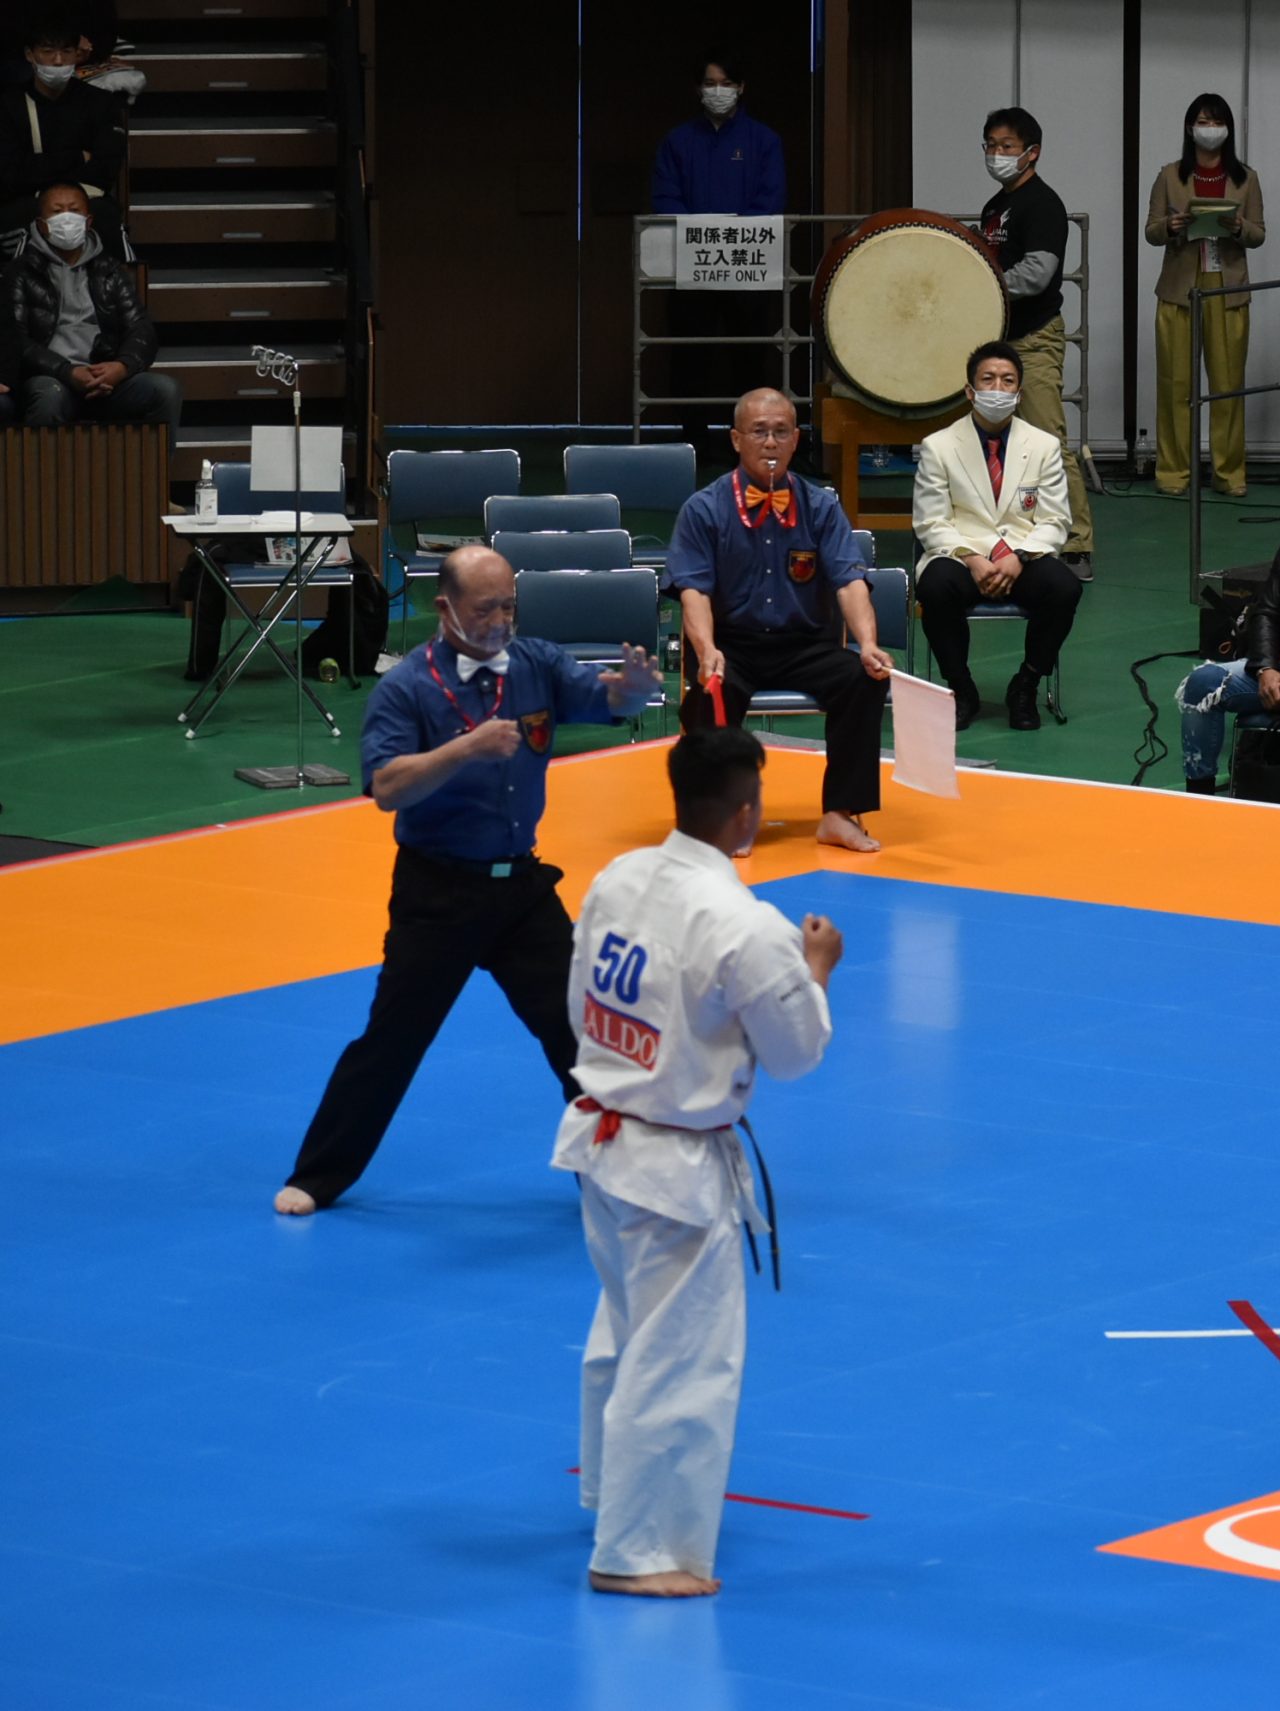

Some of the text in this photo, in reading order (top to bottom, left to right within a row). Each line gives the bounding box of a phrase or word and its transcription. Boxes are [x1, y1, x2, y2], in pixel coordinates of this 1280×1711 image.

[686, 227, 776, 244] 関係者以外
[694, 249, 766, 266] 立入禁止
[693, 270, 768, 282] STAFF ONLY
[593, 931, 647, 1006] 50
[585, 1003, 658, 1067] ALDO
